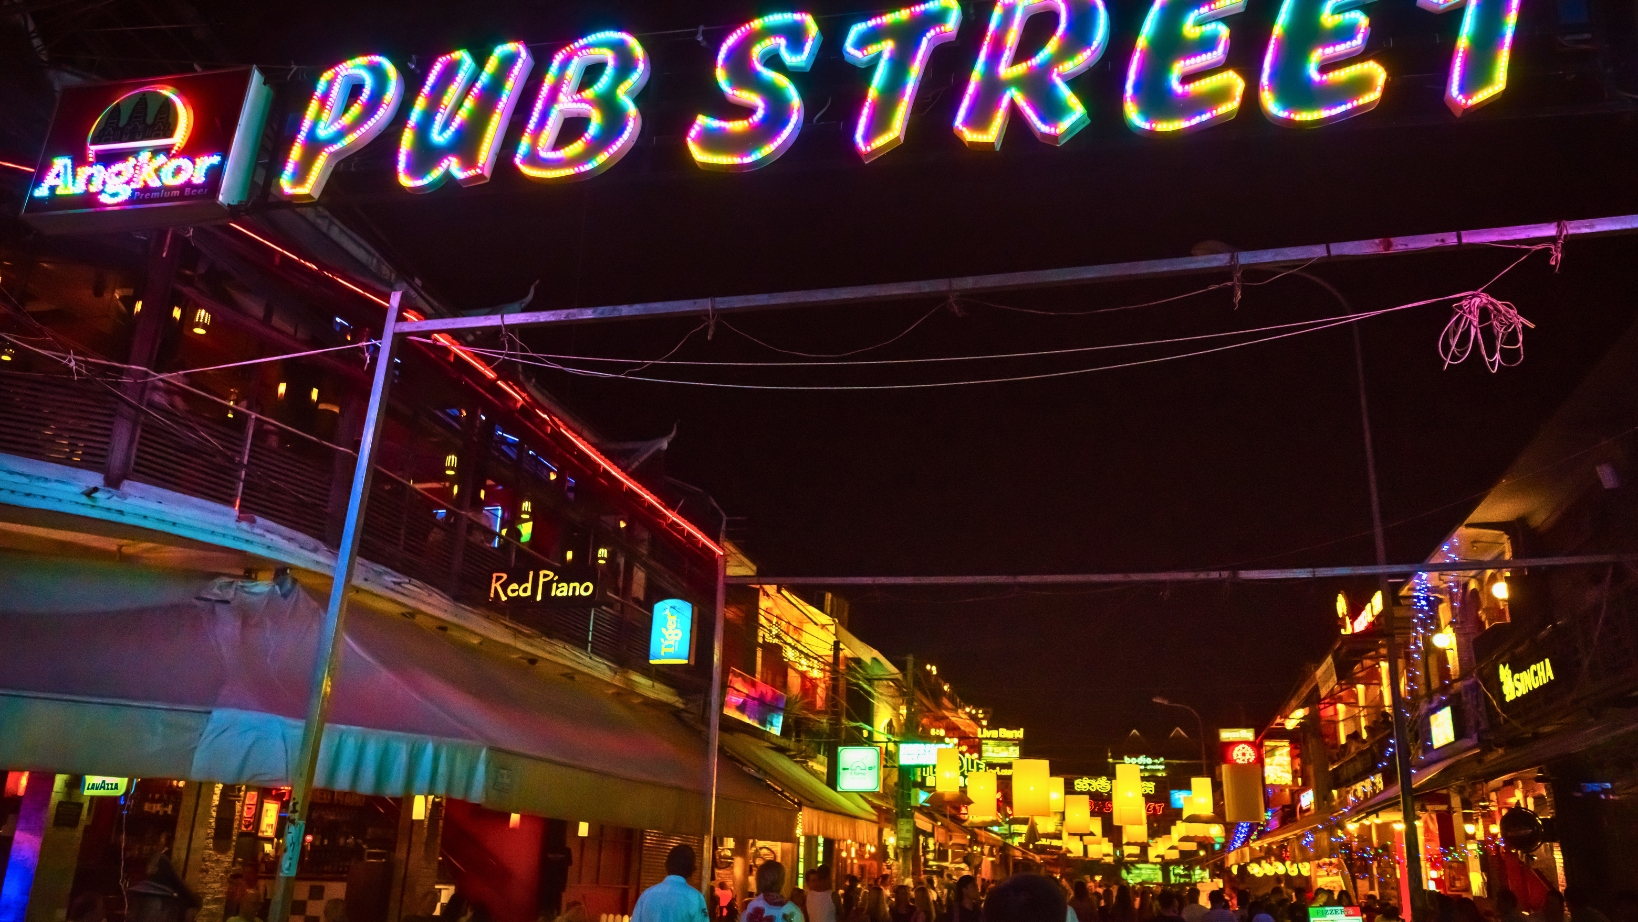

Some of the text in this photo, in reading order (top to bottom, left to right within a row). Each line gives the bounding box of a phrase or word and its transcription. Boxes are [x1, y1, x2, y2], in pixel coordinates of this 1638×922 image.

[274, 0, 1521, 201] PUB STREET
[33, 150, 223, 204] Angkor
[133, 187, 209, 200] Premium Beer
[489, 570, 594, 601] Red Piano
[660, 611, 683, 656] Tiger
[1513, 658, 1554, 697] SINGHA
[977, 728, 1024, 739] Live Band
[86, 780, 119, 791] LAVAZZA
